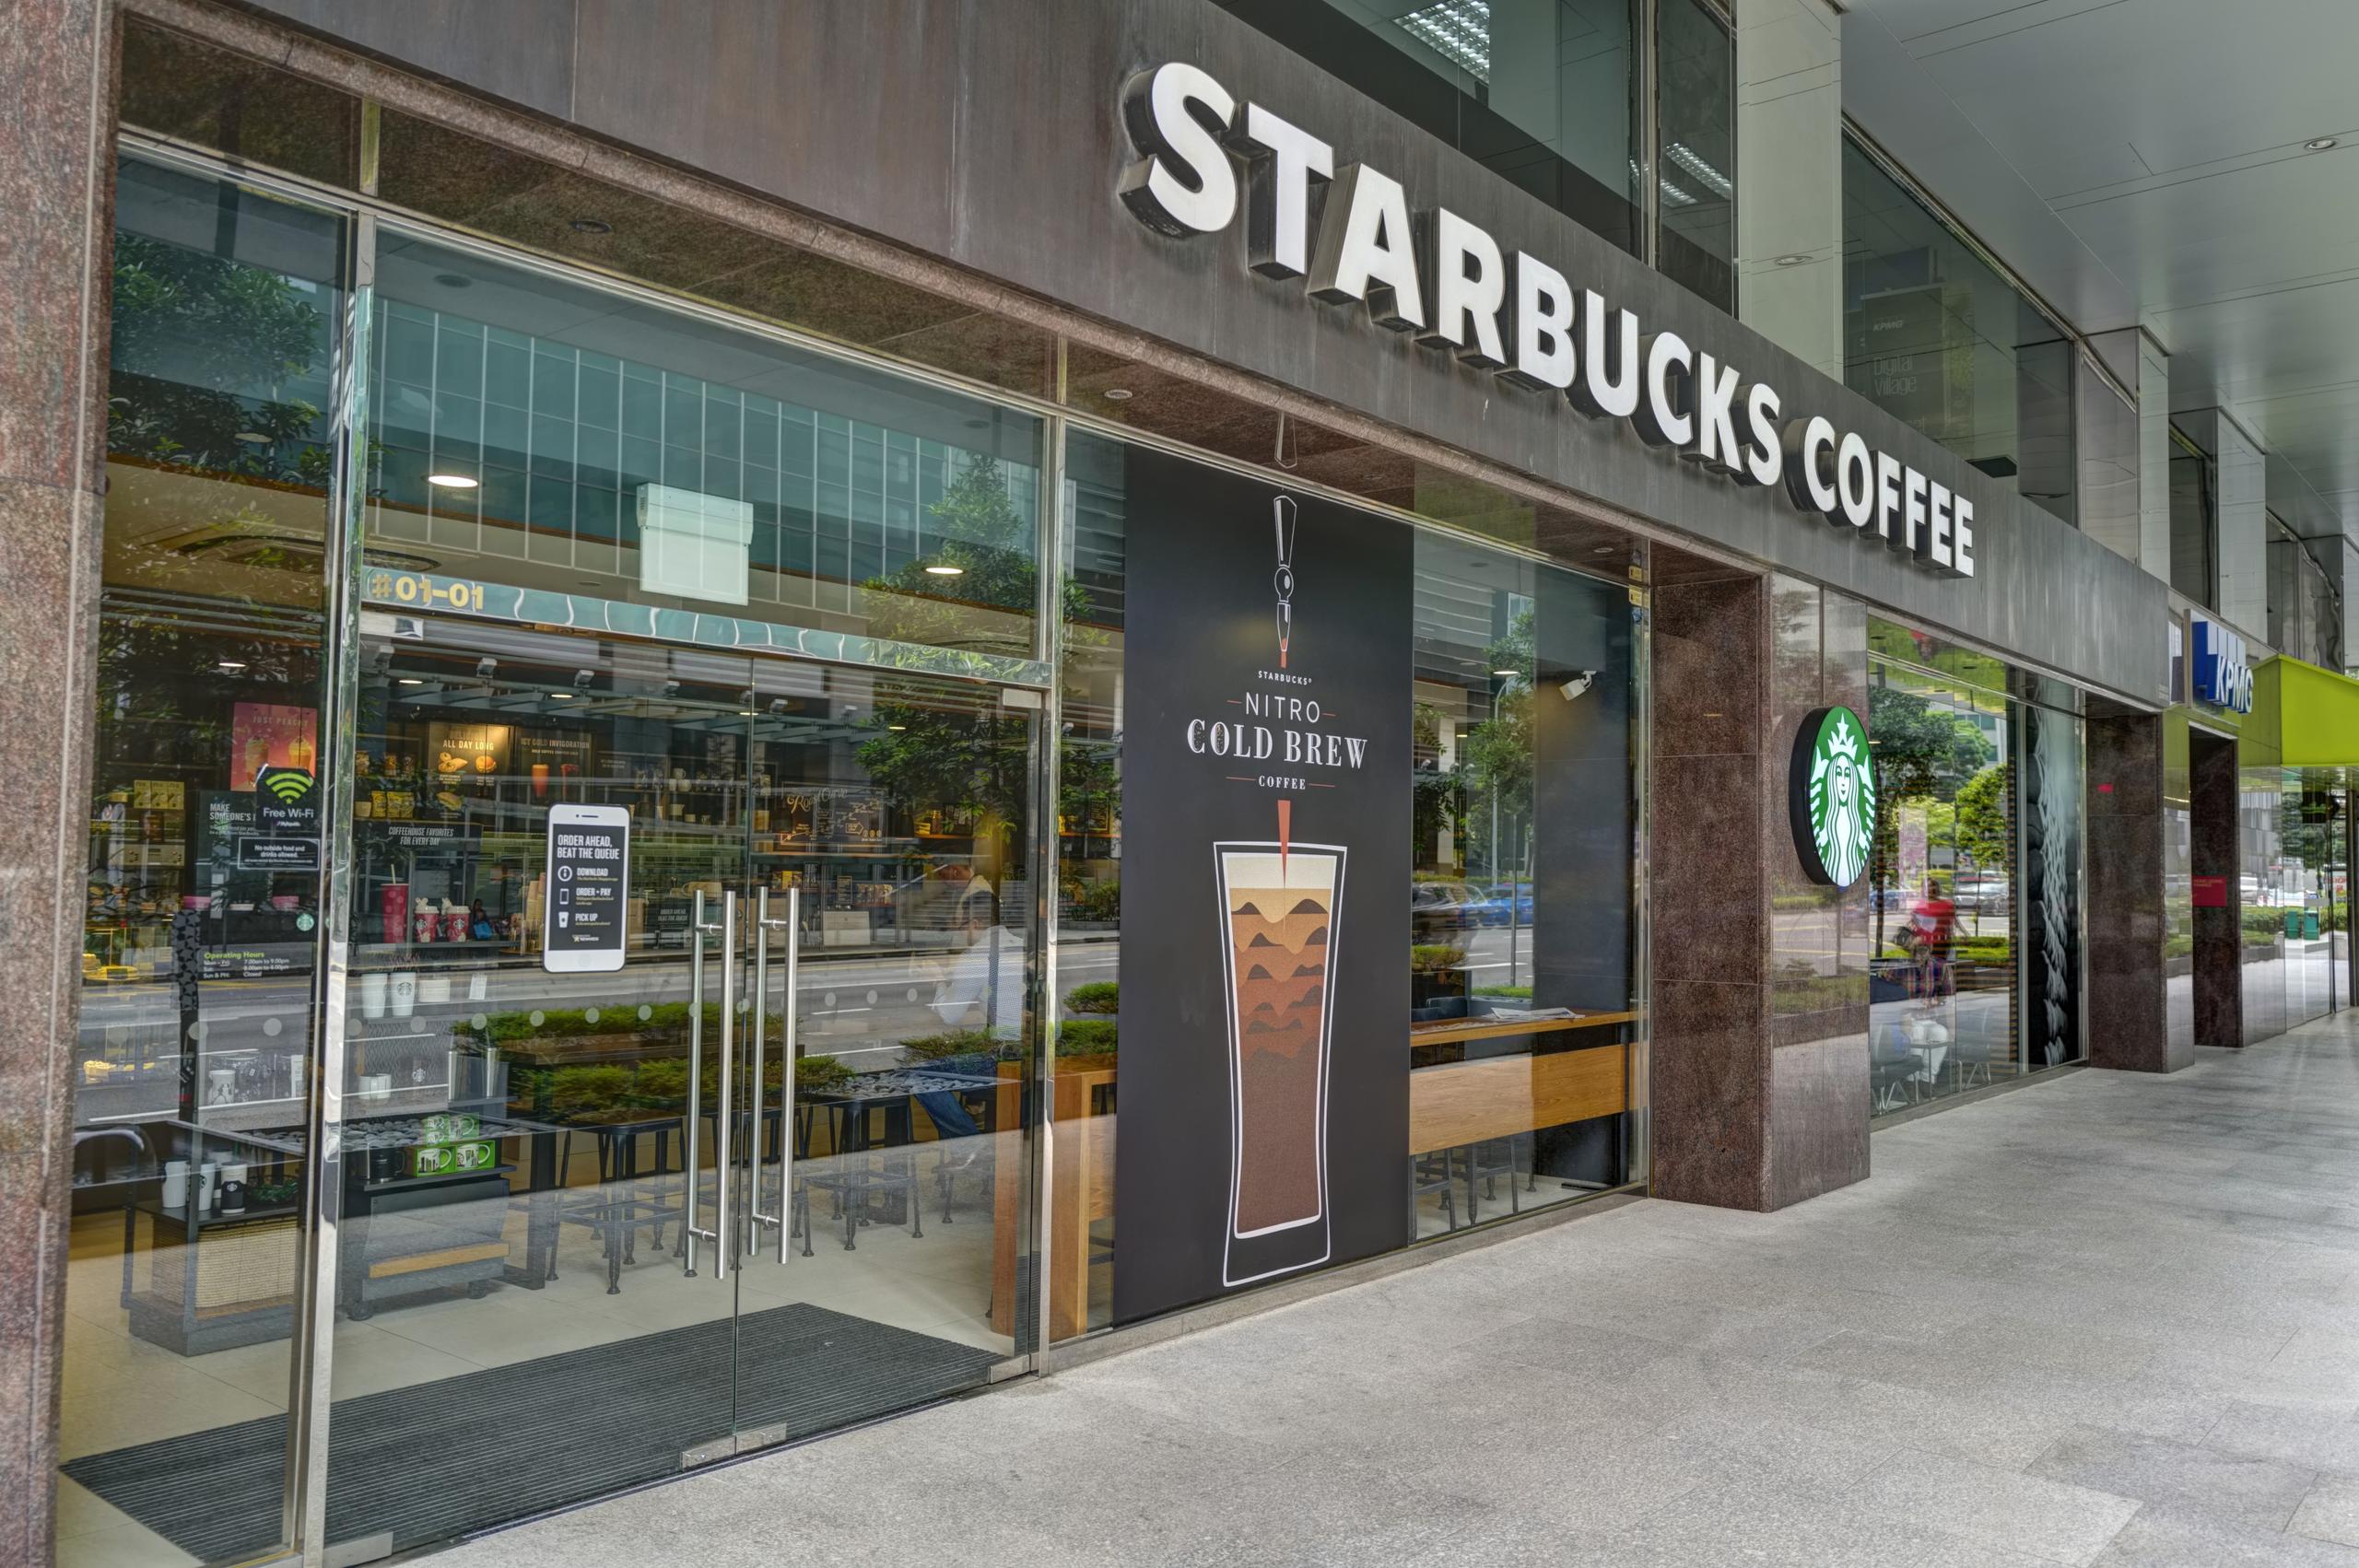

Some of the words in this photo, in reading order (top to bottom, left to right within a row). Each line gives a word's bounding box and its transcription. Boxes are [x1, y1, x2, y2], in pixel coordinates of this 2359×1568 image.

[1146, 62, 1781, 486] STARBUCKS
[1803, 415, 1975, 578] COFFEE
[1874, 375, 1917, 397] village
[371, 574, 484, 610] #01-01
[2215, 655, 2254, 714] KPMG
[1246, 692, 1320, 723] NITRO
[442, 739, 456, 748] ALL
[458, 740, 473, 750] DAY
[475, 741, 495, 751] LONG
[1187, 719, 1273, 759] COLD
[1284, 730, 1368, 769] BREW
[1258, 776, 1306, 790] COFFEE
[209, 803, 230, 812] MAKE
[263, 807, 286, 818] Free
[288, 808, 314, 819] Wi-Fi
[209, 812, 251, 821] SOMEONE'S
[400, 837, 411, 846] FOR
[429, 837, 440, 846] DAY
[557, 834, 584, 847] ORDER
[585, 835, 613, 848] AHEAD,
[557, 847, 578, 859] BEAT
[578, 848, 593, 859] THE
[594, 848, 620, 860] QUEUE
[577, 867, 608, 876] DOWNLOAD
[576, 887, 595, 896] ORDER
[600, 888, 612, 896] PAY
[575, 913, 589, 922] PICK
[590, 913, 598, 922] UP
[204, 952, 241, 960] Operating
[242, 951, 265, 959] Hours
